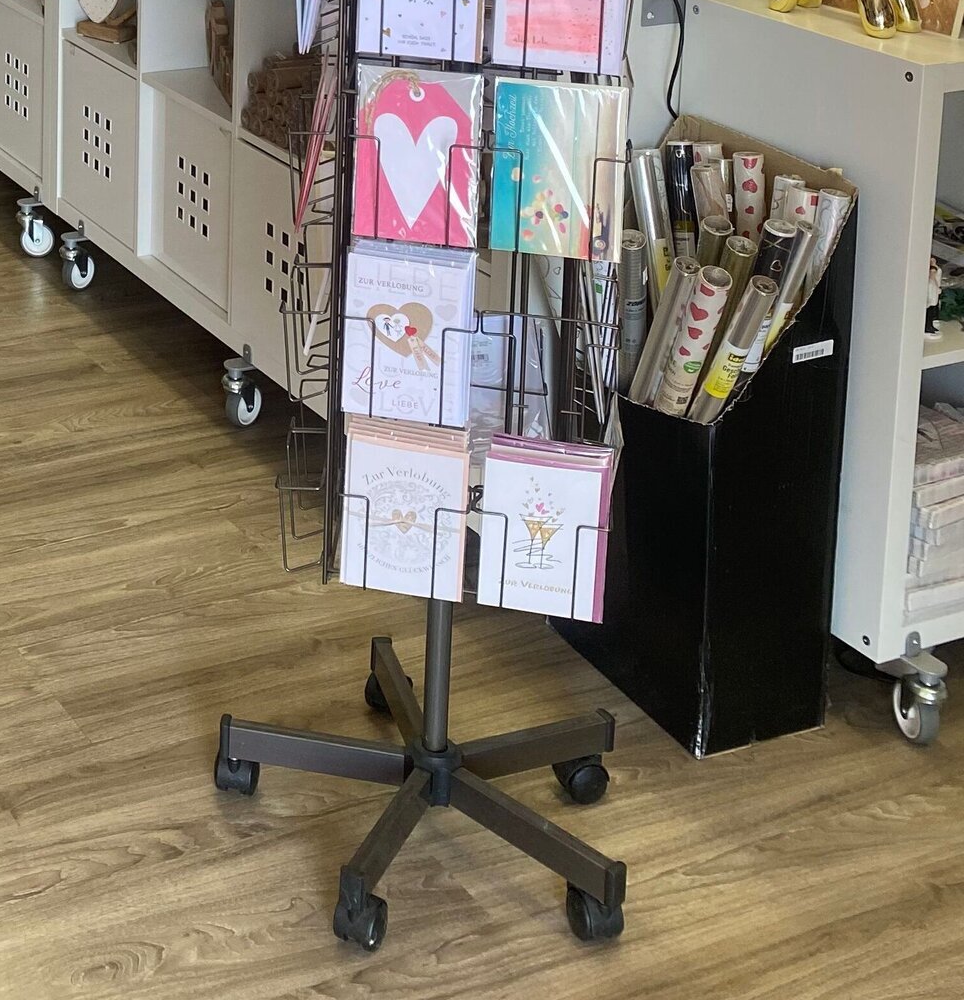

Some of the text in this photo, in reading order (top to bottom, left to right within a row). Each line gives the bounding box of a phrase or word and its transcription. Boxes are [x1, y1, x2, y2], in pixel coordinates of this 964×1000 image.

[502, 93, 517, 138] Hochzeit
[358, 277, 424, 293] ZUR VERLOBUNG
[352, 366, 402, 394] Love
[384, 366, 439, 379] ZUR VERLOBUNG
[391, 400, 419, 410] LIEBE
[362, 467, 451, 500] Zur Verlobung
